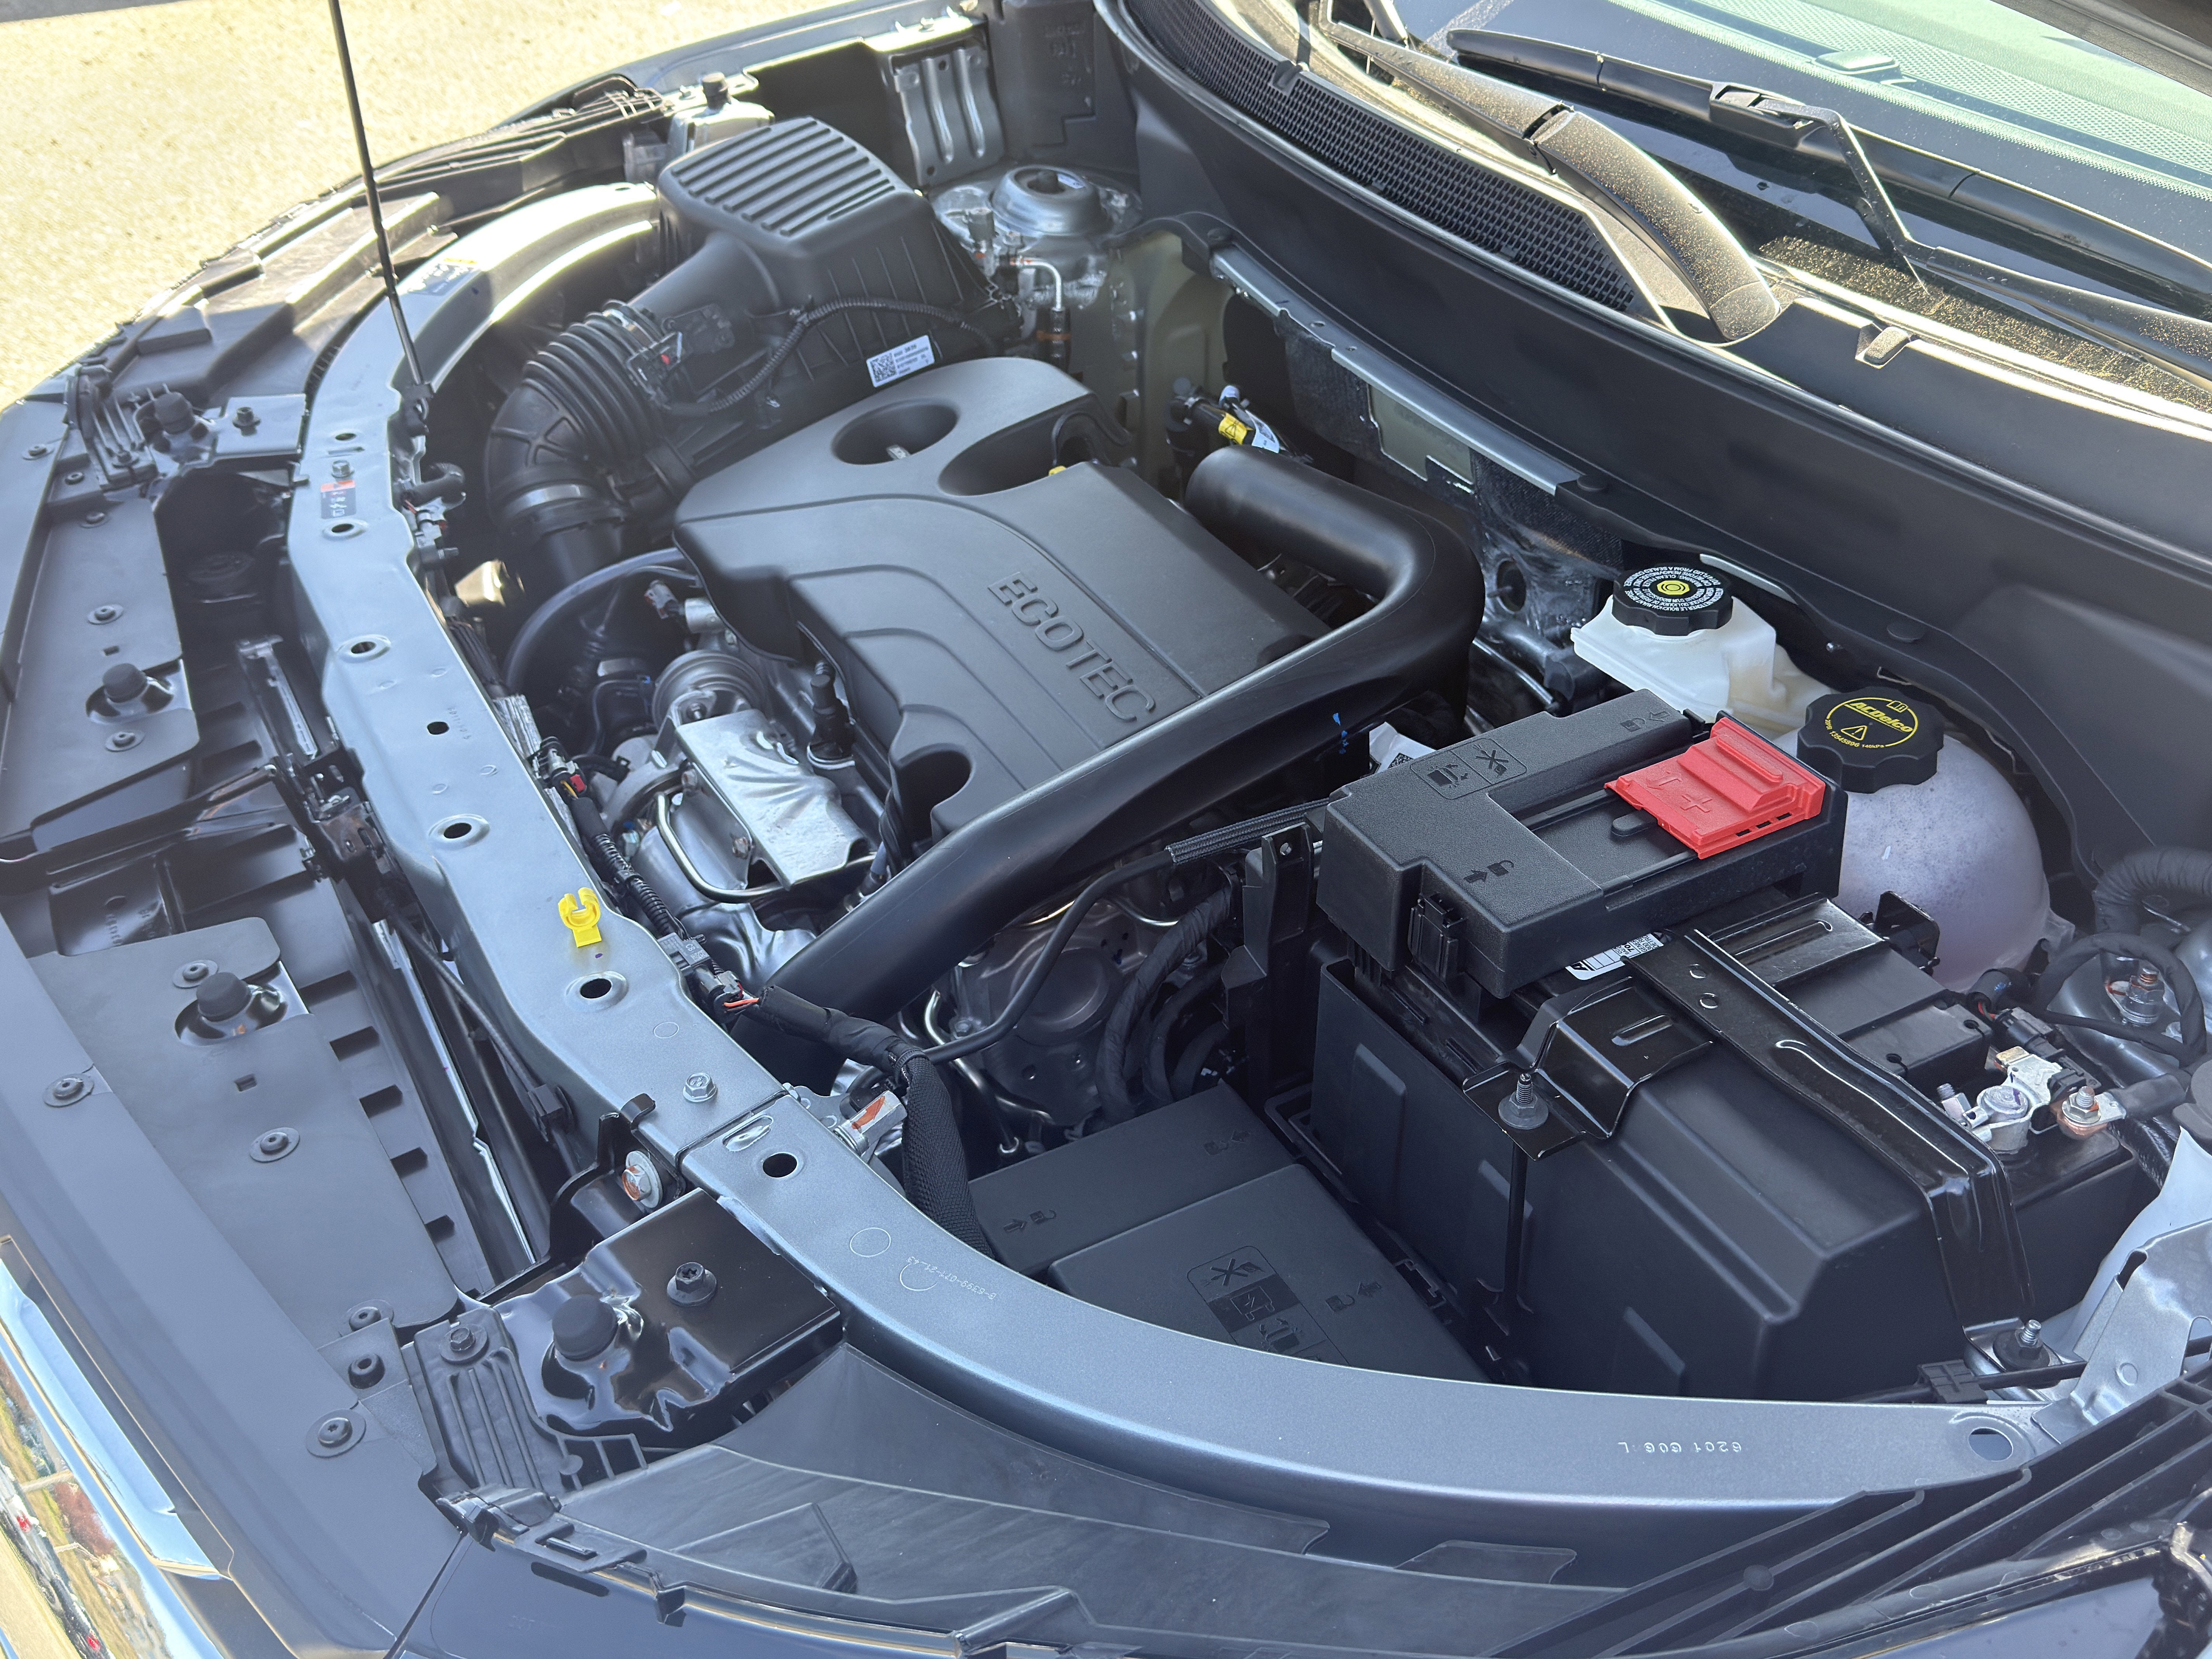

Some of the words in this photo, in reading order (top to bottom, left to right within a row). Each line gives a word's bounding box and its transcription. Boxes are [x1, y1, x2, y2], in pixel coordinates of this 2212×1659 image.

[1681, 572, 1704, 580] BEFORE
[987, 571, 1156, 722] ECOTEC
[1850, 702, 1913, 732] ACDelco
[1829, 731, 1860, 747] 13545896
[1621, 943, 1636, 952] 70
[1617, 1442, 1629, 1453] L
[1644, 1442, 1681, 1453] 606
[1694, 1441, 1741, 1453] 6201
